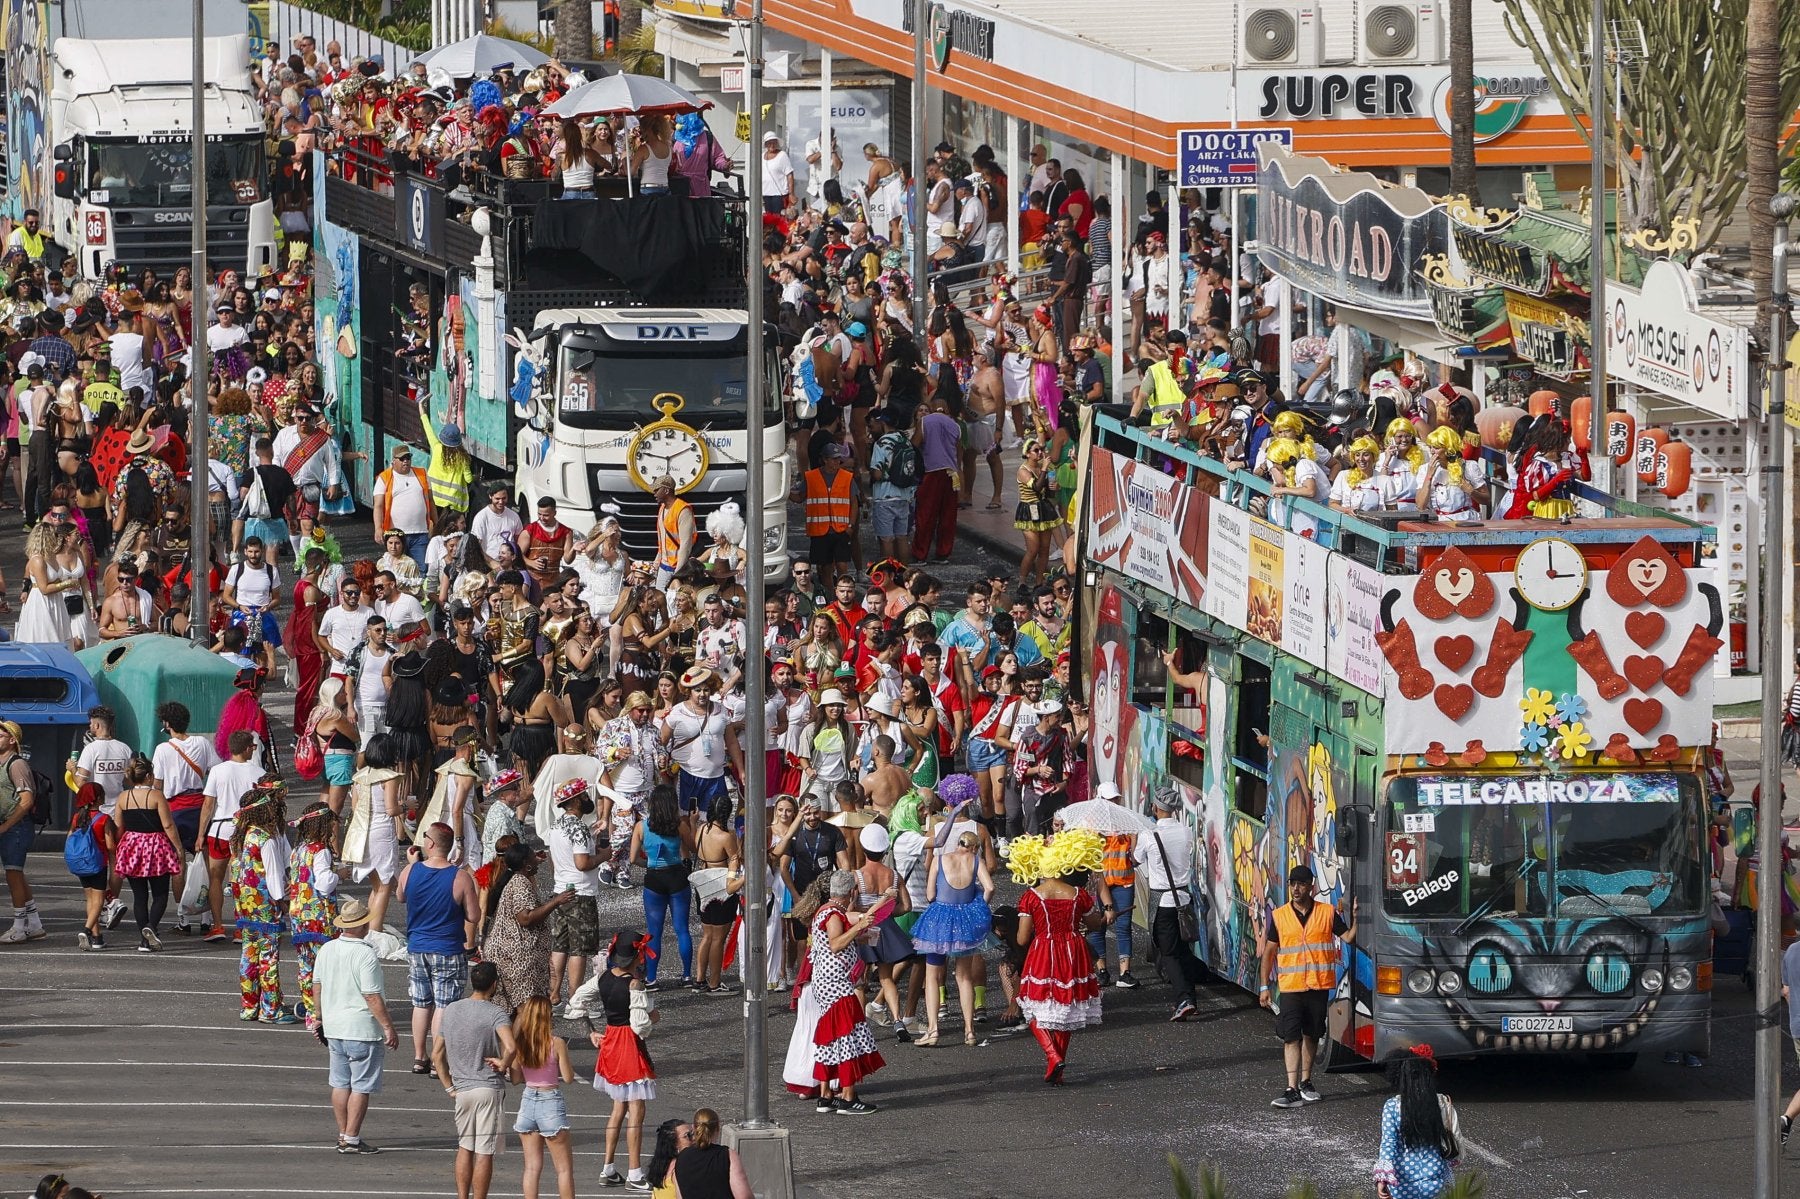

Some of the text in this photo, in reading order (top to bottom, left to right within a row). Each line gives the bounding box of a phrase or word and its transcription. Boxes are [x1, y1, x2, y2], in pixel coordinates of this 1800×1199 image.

[724, 71, 743, 90] Bild
[1259, 74, 1414, 117] SUPER
[831, 107, 866, 117] EURO
[138, 134, 223, 144] Menrotns
[1188, 133, 1284, 151] DOCTOR
[1198, 151, 1224, 160] ARZT
[1188, 164, 1222, 174] 24Hrs.
[1199, 176, 1216, 184] 928
[155, 212, 208, 223] SCAN
[87, 221, 101, 237] 36
[1270, 190, 1392, 282] SILKROAD
[637, 325, 709, 339] DAF
[1521, 322, 1556, 364] BUFFET
[1637, 318, 1655, 358] MR
[1636, 363, 1690, 395] JAPANESE RESTAURANT
[569, 382, 588, 402] 35
[653, 431, 660, 441] 11
[665, 429, 675, 439] 12
[640, 440, 651, 450] 10
[691, 443, 697, 452] 2
[636, 452, 642, 461] 9
[696, 454, 702, 463] 3
[640, 465, 647, 475] 8
[690, 467, 696, 476] 4
[679, 477, 685, 486] 5
[1154, 485, 1173, 524] 2000
[1421, 780, 1632, 804] TELCARROZA
[1391, 848, 1418, 874] 34
[1402, 870, 1459, 907] Balage
[1509, 1018, 1572, 1030] GC 0272 AJ
